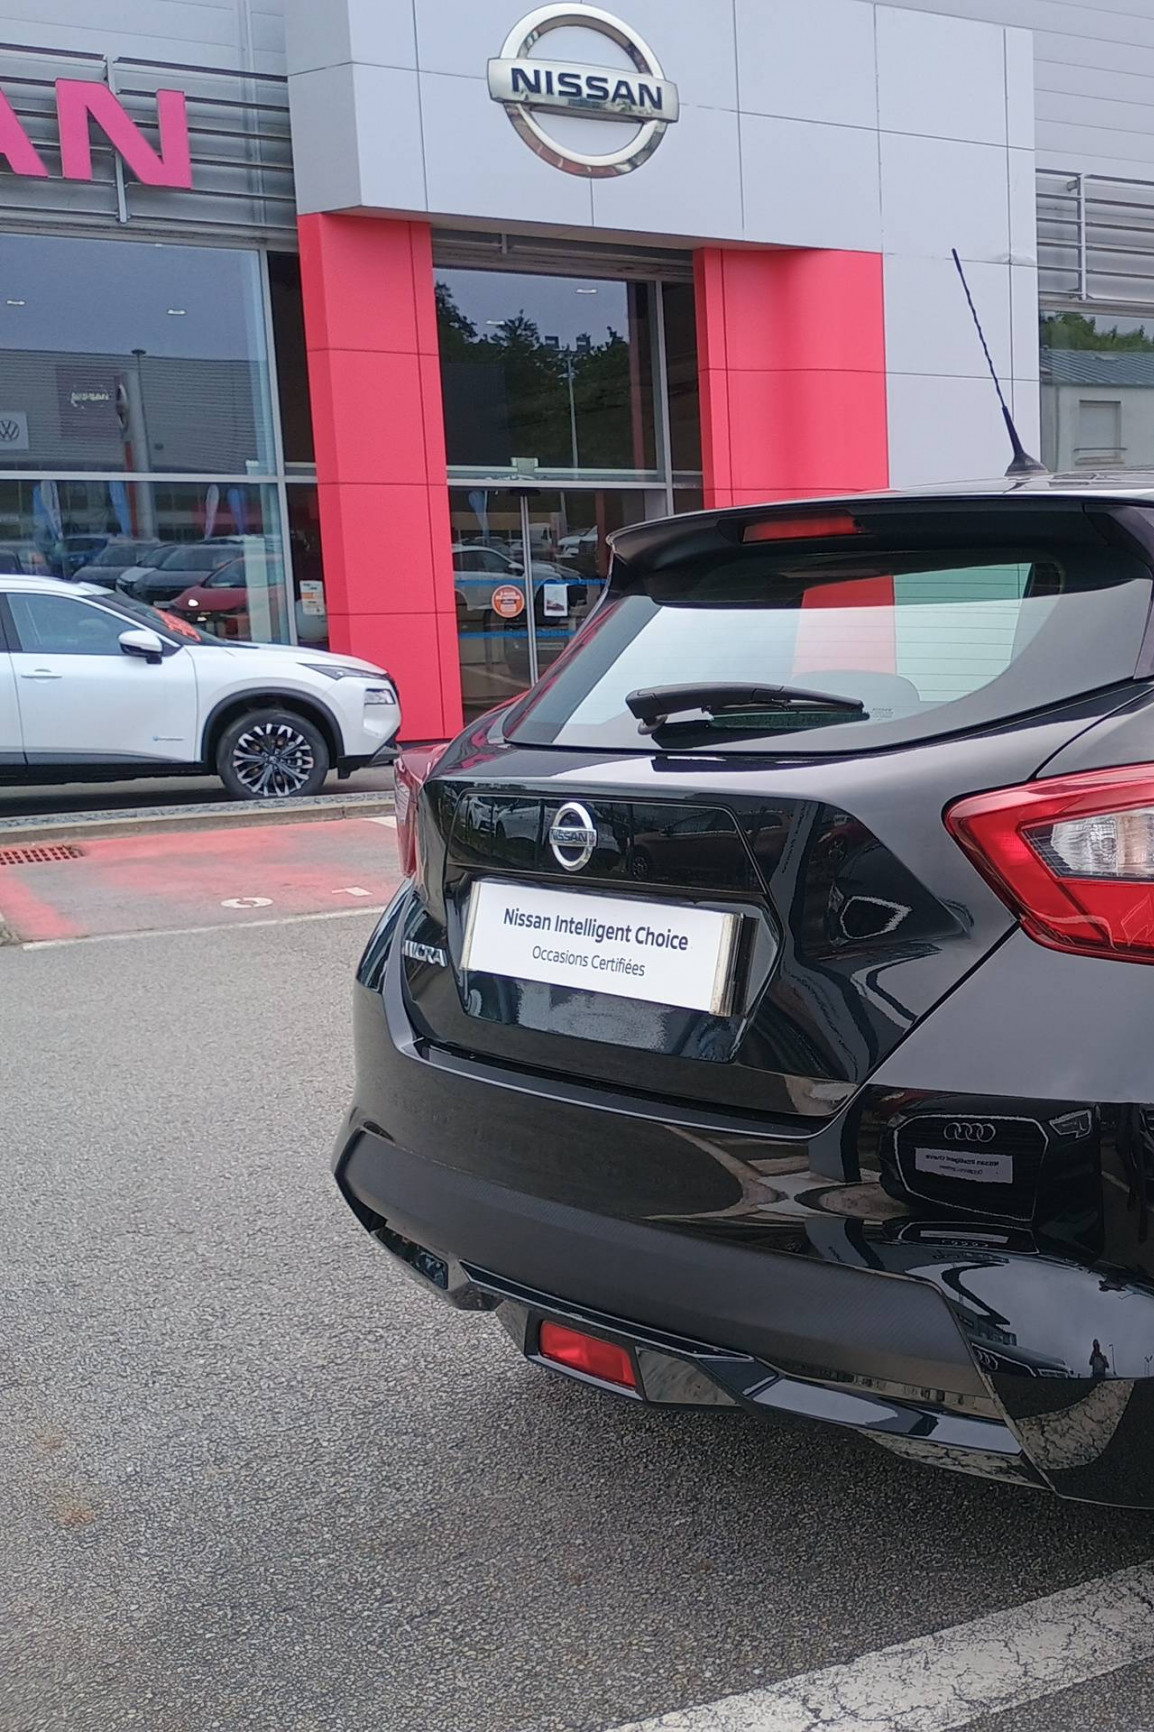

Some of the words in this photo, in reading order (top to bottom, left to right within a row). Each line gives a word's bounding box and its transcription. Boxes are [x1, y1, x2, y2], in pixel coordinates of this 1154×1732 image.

[510, 67, 663, 111] NISSAN
[551, 828, 588, 842] NISSAN
[503, 907, 552, 931] Nissan
[554, 915, 632, 943] Intelligent
[635, 926, 689, 951] Choice
[532, 945, 589, 967] Occasions
[591, 955, 646, 977] Certifiées
